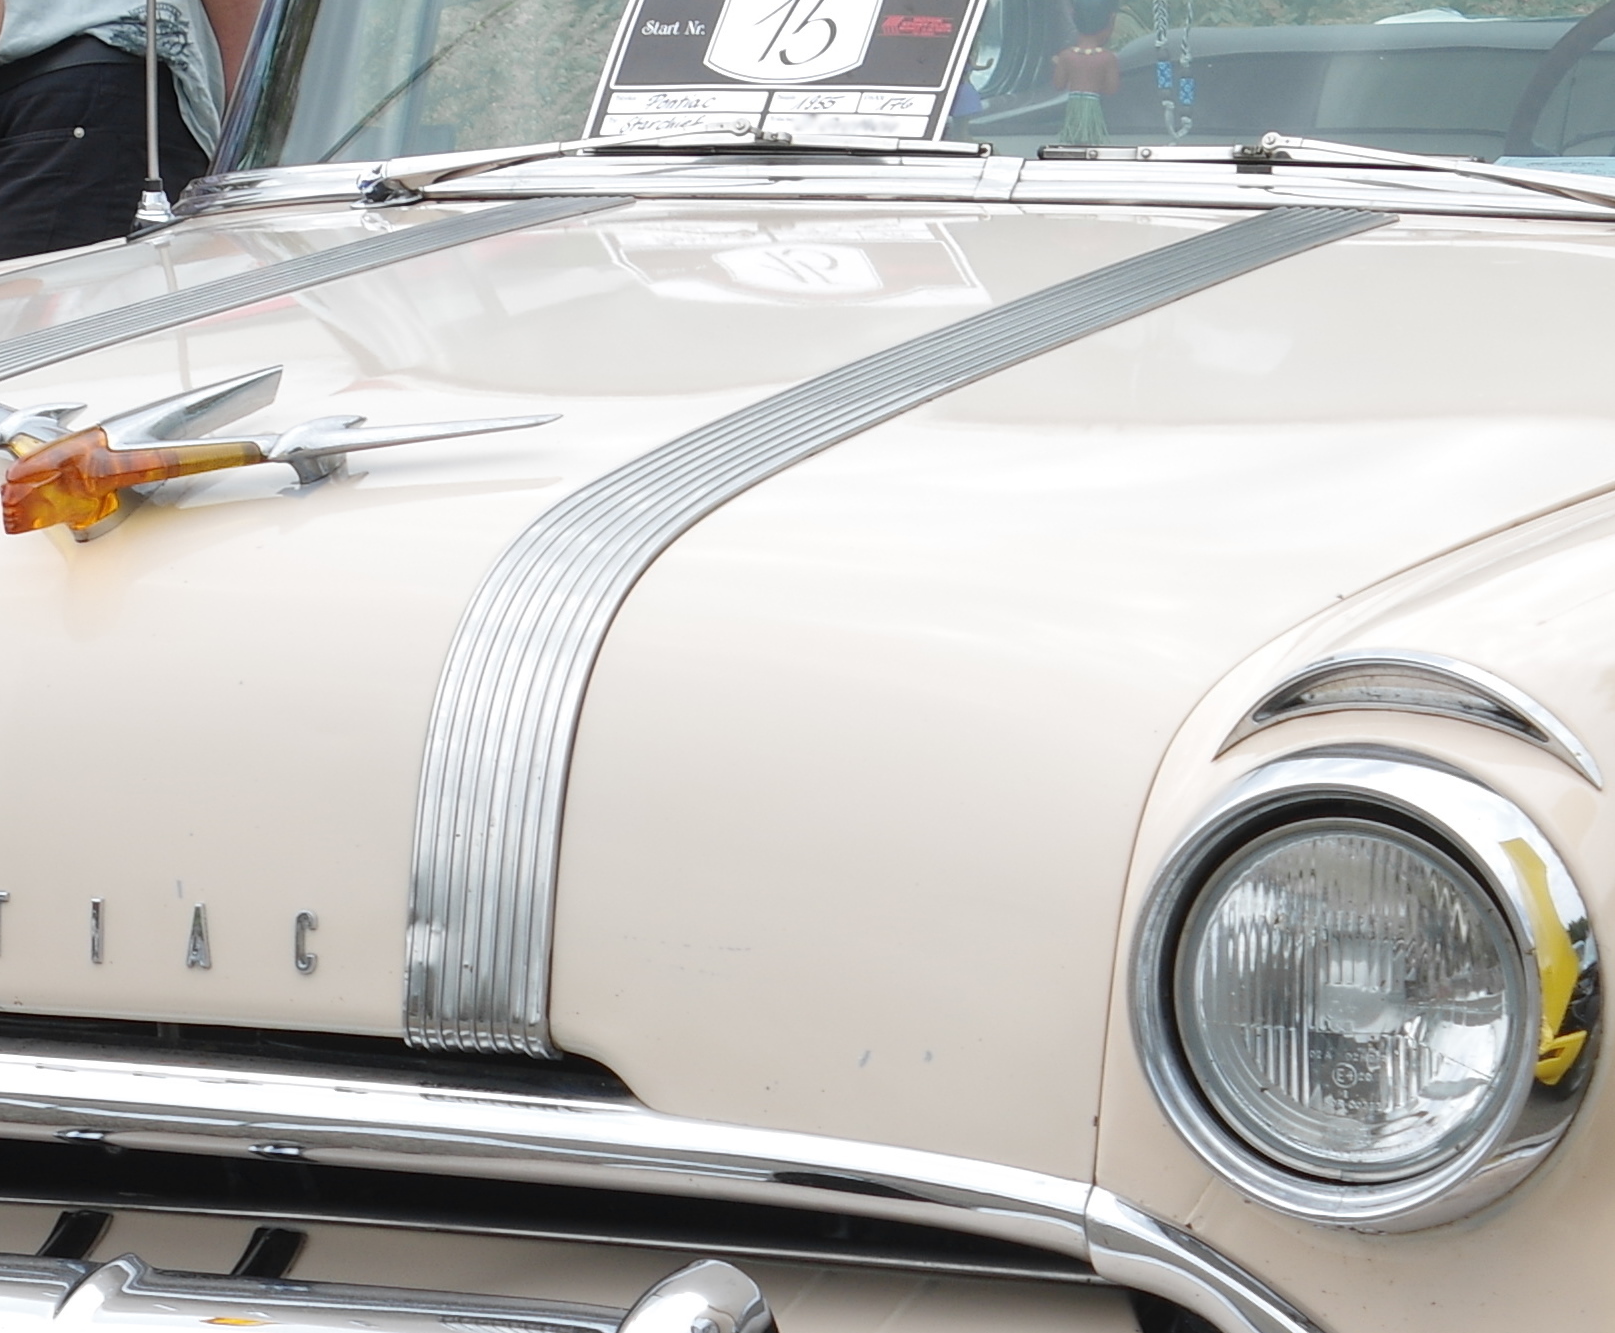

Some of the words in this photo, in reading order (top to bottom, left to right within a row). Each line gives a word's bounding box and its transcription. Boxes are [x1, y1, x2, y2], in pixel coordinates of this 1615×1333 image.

[641, 20, 680, 36] Start
[684, 20, 706, 36] Nr.
[645, 93, 717, 110] Pontiac
[791, 94, 846, 111] 1955
